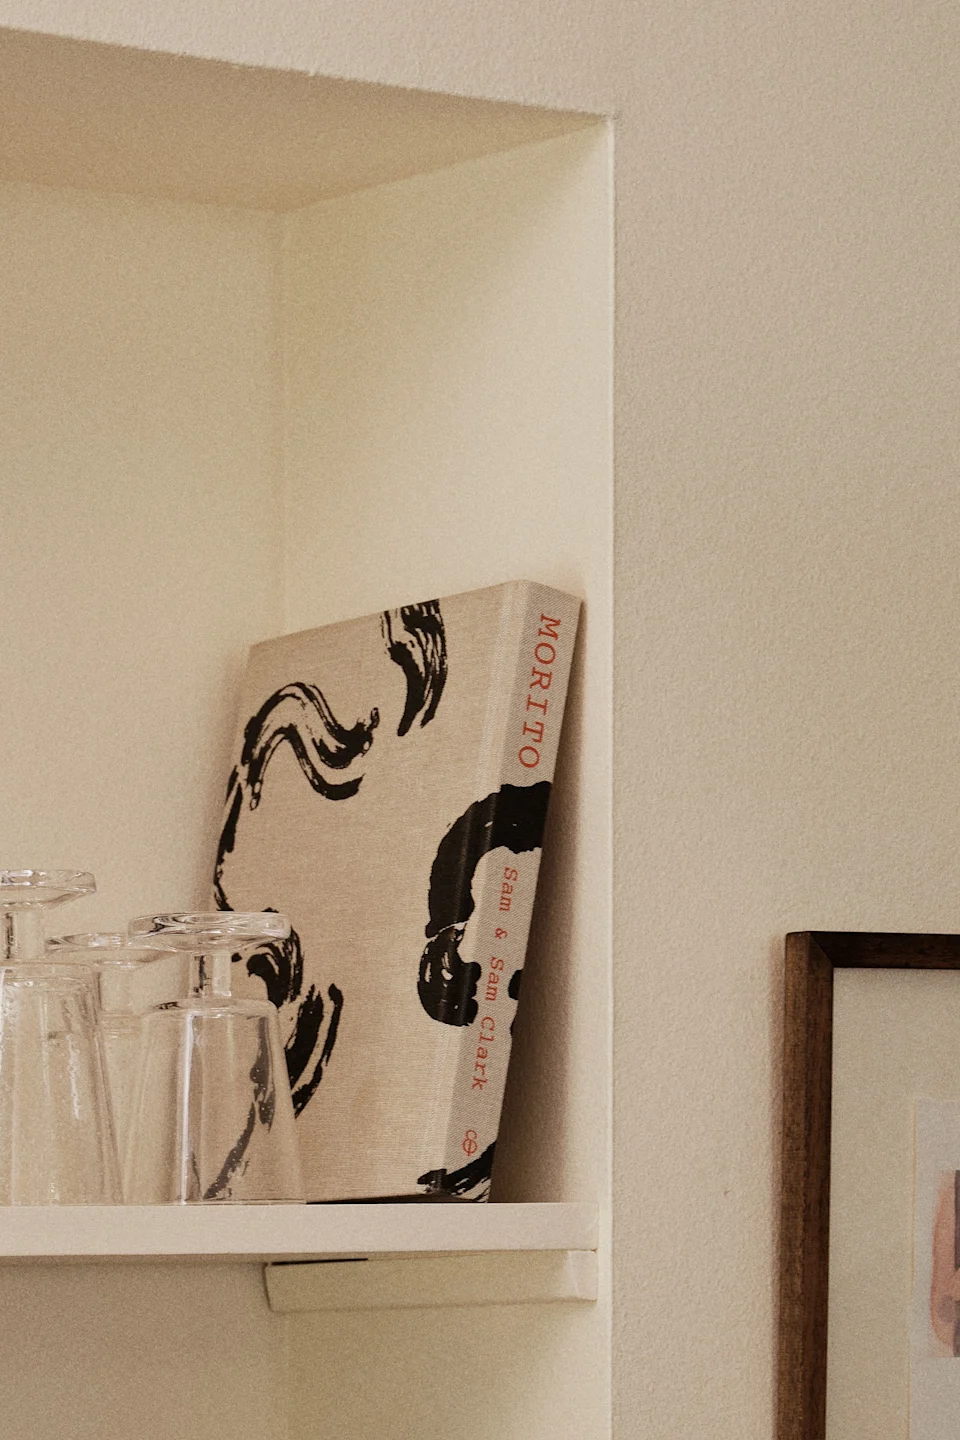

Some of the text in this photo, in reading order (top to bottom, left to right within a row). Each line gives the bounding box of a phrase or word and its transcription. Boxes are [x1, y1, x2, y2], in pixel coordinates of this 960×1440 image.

[518, 613, 561, 768] MORITO
[472, 866, 518, 1091] Sam & Sam Clark
